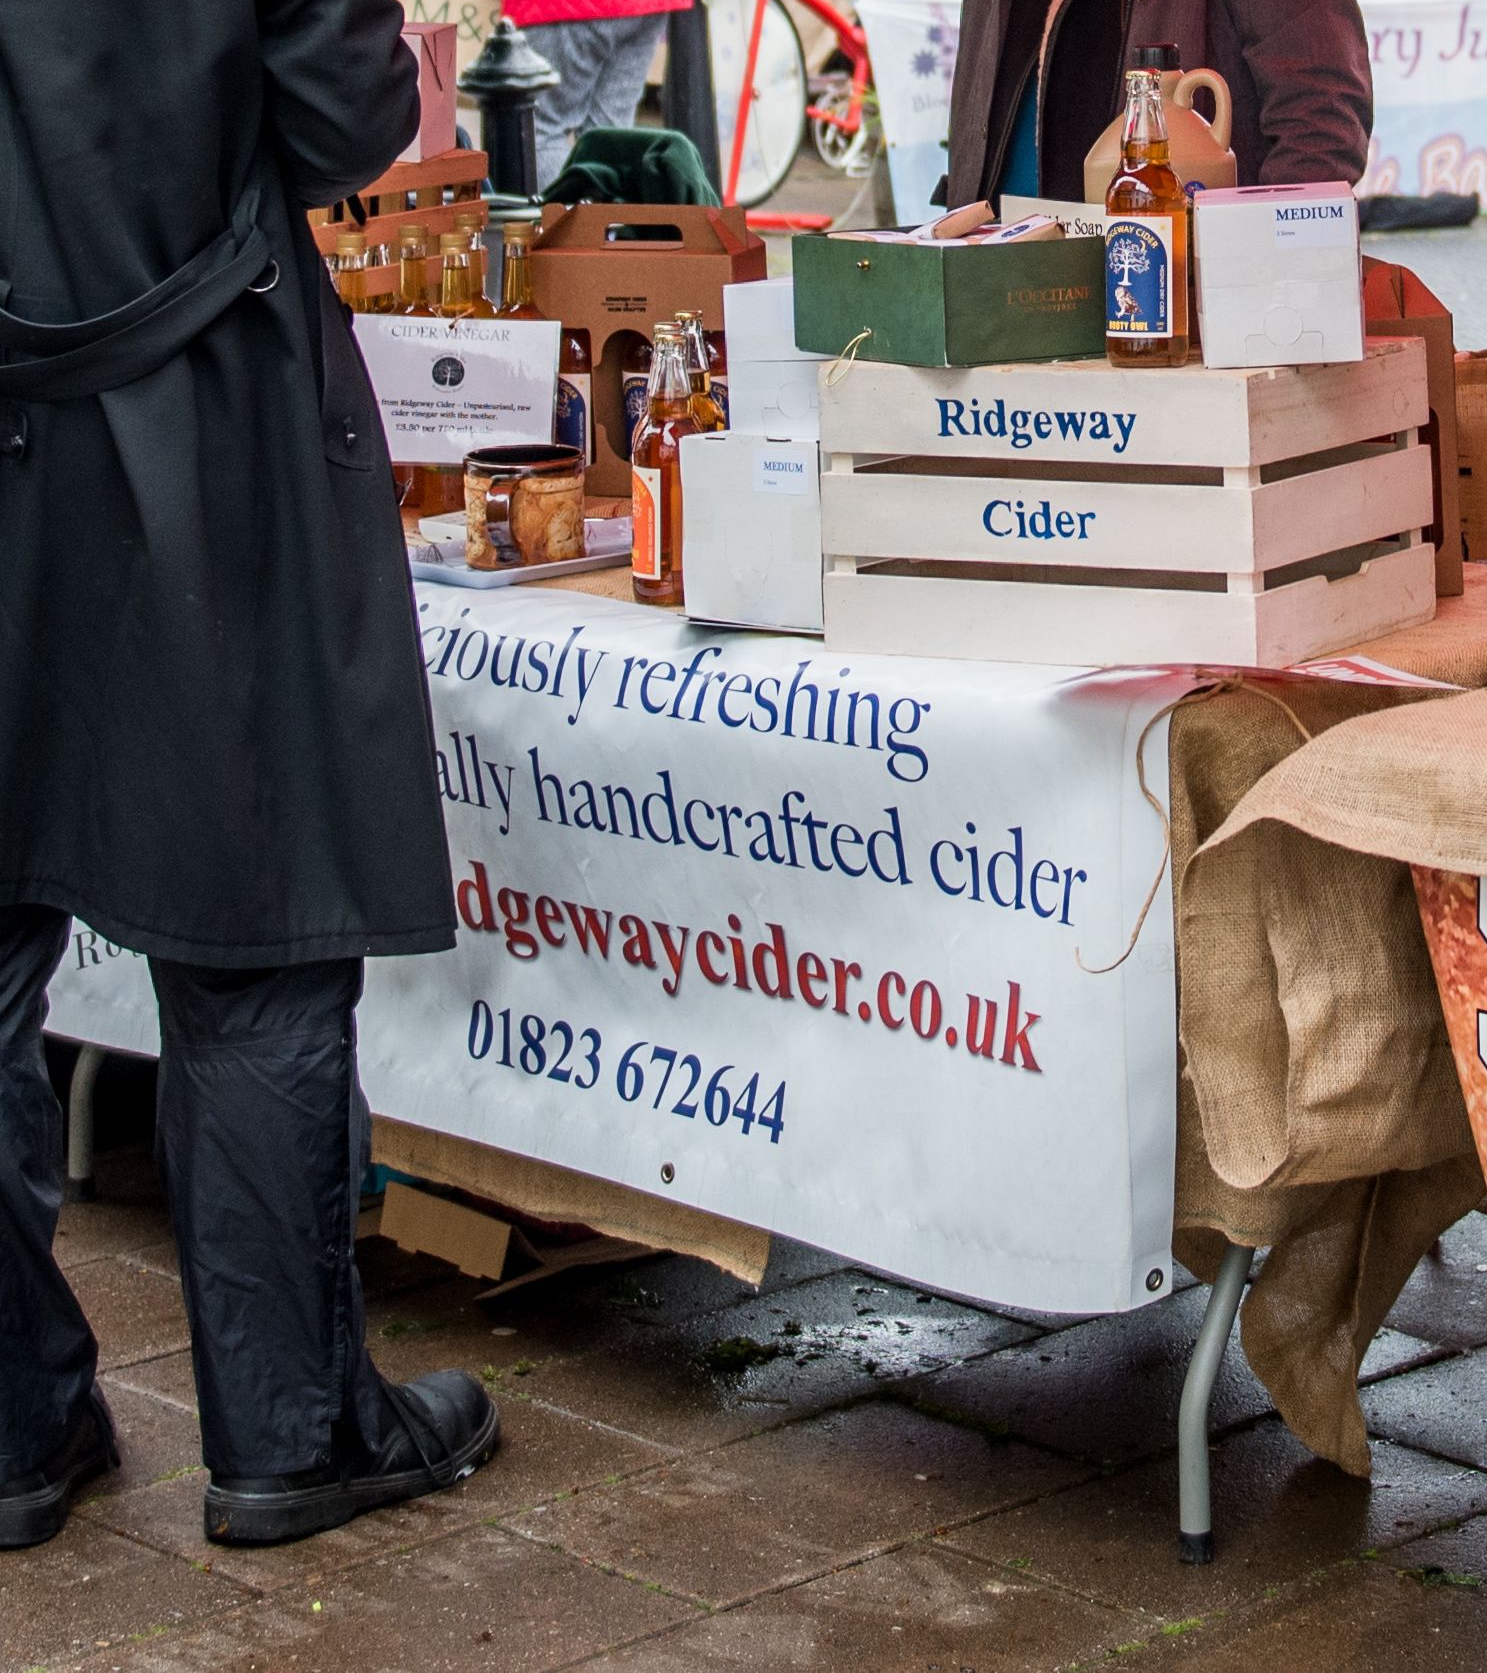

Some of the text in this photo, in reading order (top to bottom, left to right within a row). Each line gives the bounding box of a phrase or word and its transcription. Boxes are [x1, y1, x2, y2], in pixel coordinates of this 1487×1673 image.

[1275, 206, 1344, 221] MEDIUM
[1074, 217, 1102, 236] Soap
[1135, 228, 1160, 249] CIDER
[391, 325, 510, 341] CIDER VINEGAR
[381, 398, 399, 407] from
[400, 399, 434, 410] Ridgeway
[391, 409, 498, 420] cider vinegar with the mother.
[934, 398, 1137, 453] Ridgeway
[763, 460, 804, 474] MEDIUM
[982, 499, 1096, 540] Cider
[419, 606, 932, 782] ciously refreshing
[527, 747, 913, 886] handcrafted
[929, 821, 1087, 928] cider
[455, 860, 1044, 1074] dgewaycider.co.uk
[467, 999, 789, 1144] 01823 672644
